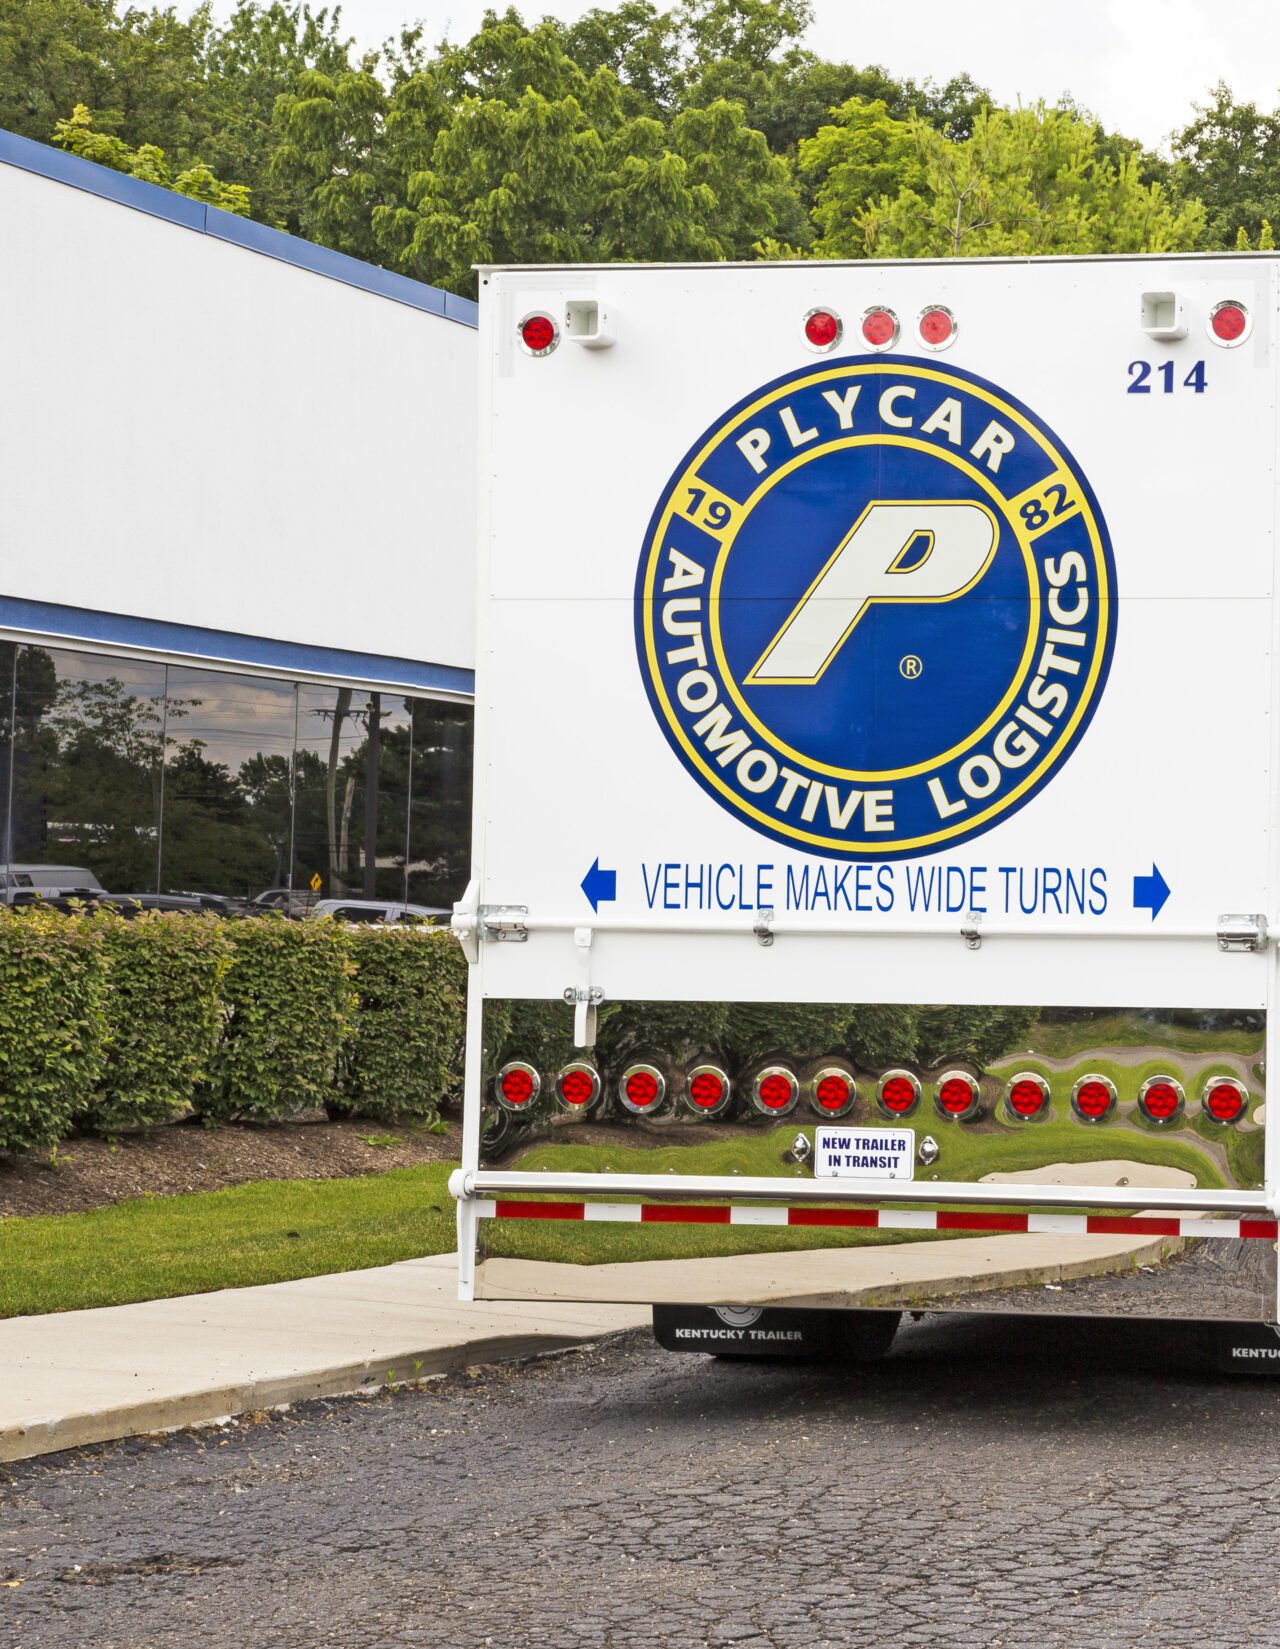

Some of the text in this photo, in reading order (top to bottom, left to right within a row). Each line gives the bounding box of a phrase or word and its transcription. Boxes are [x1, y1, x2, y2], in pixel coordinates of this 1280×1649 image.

[1127, 360, 1209, 395] 214
[736, 384, 1017, 476] PLYCAR
[685, 486, 733, 532] 19
[1020, 482, 1077, 533] 82
[742, 499, 1001, 686] P
[661, 547, 1088, 833] AUTOMOTIVE LOGISTICS
[642, 863, 1108, 915] VEHICLE MAKES WIDE TURNS
[822, 1137, 906, 1151] NEW TRAILER
[828, 1155, 900, 1168] IN TRANSIT
[675, 1328, 803, 1341] KENTUCKY TRAILER
